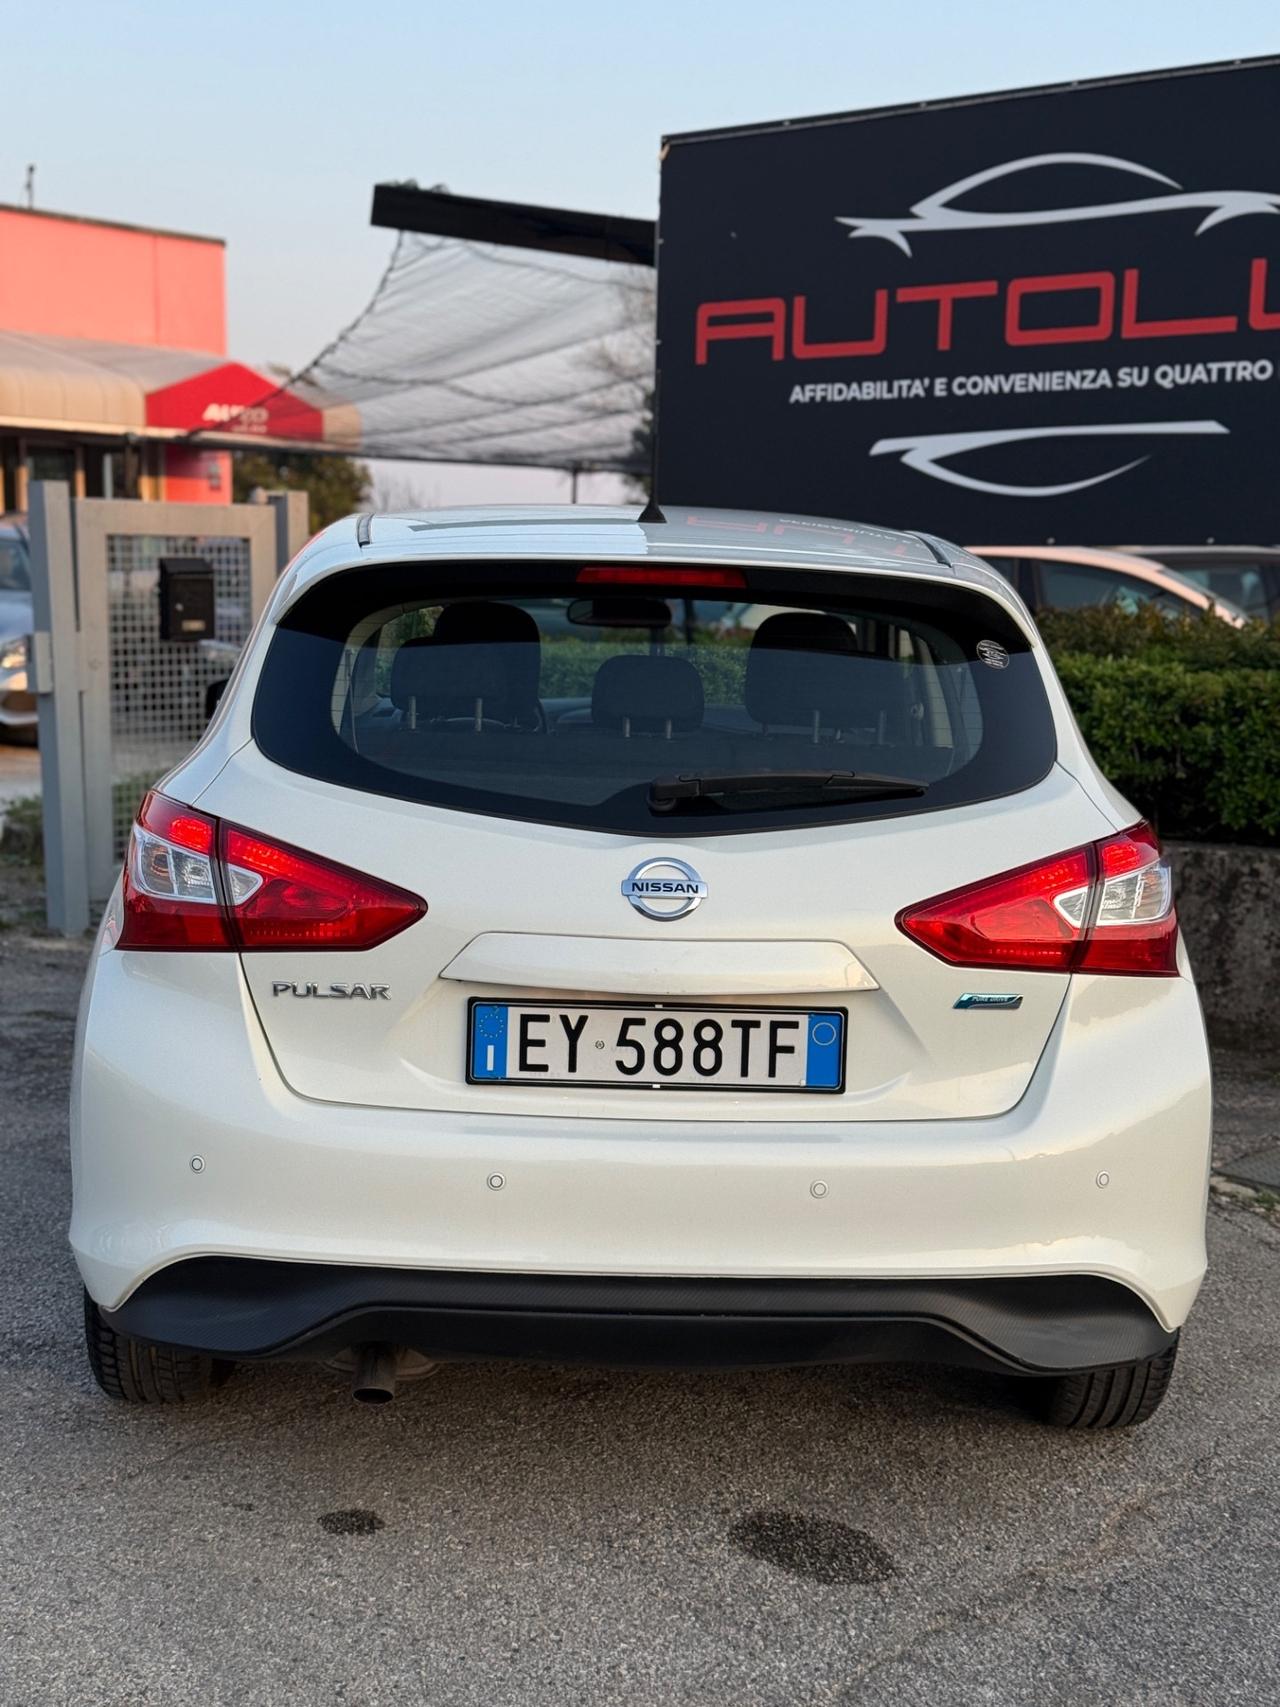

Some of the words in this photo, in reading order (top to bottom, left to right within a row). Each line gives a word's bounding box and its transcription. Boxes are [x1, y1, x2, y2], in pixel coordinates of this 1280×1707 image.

[933, 377, 948, 397] E
[951, 367, 1113, 396] CONVENIENZA
[1116, 366, 1150, 388] SU
[1153, 359, 1274, 389] QUATTRO
[631, 881, 699, 894] NISSAN
[272, 981, 391, 1000] PULSAR
[519, 1013, 589, 1073] EY
[615, 1018, 800, 1077] 588TF
